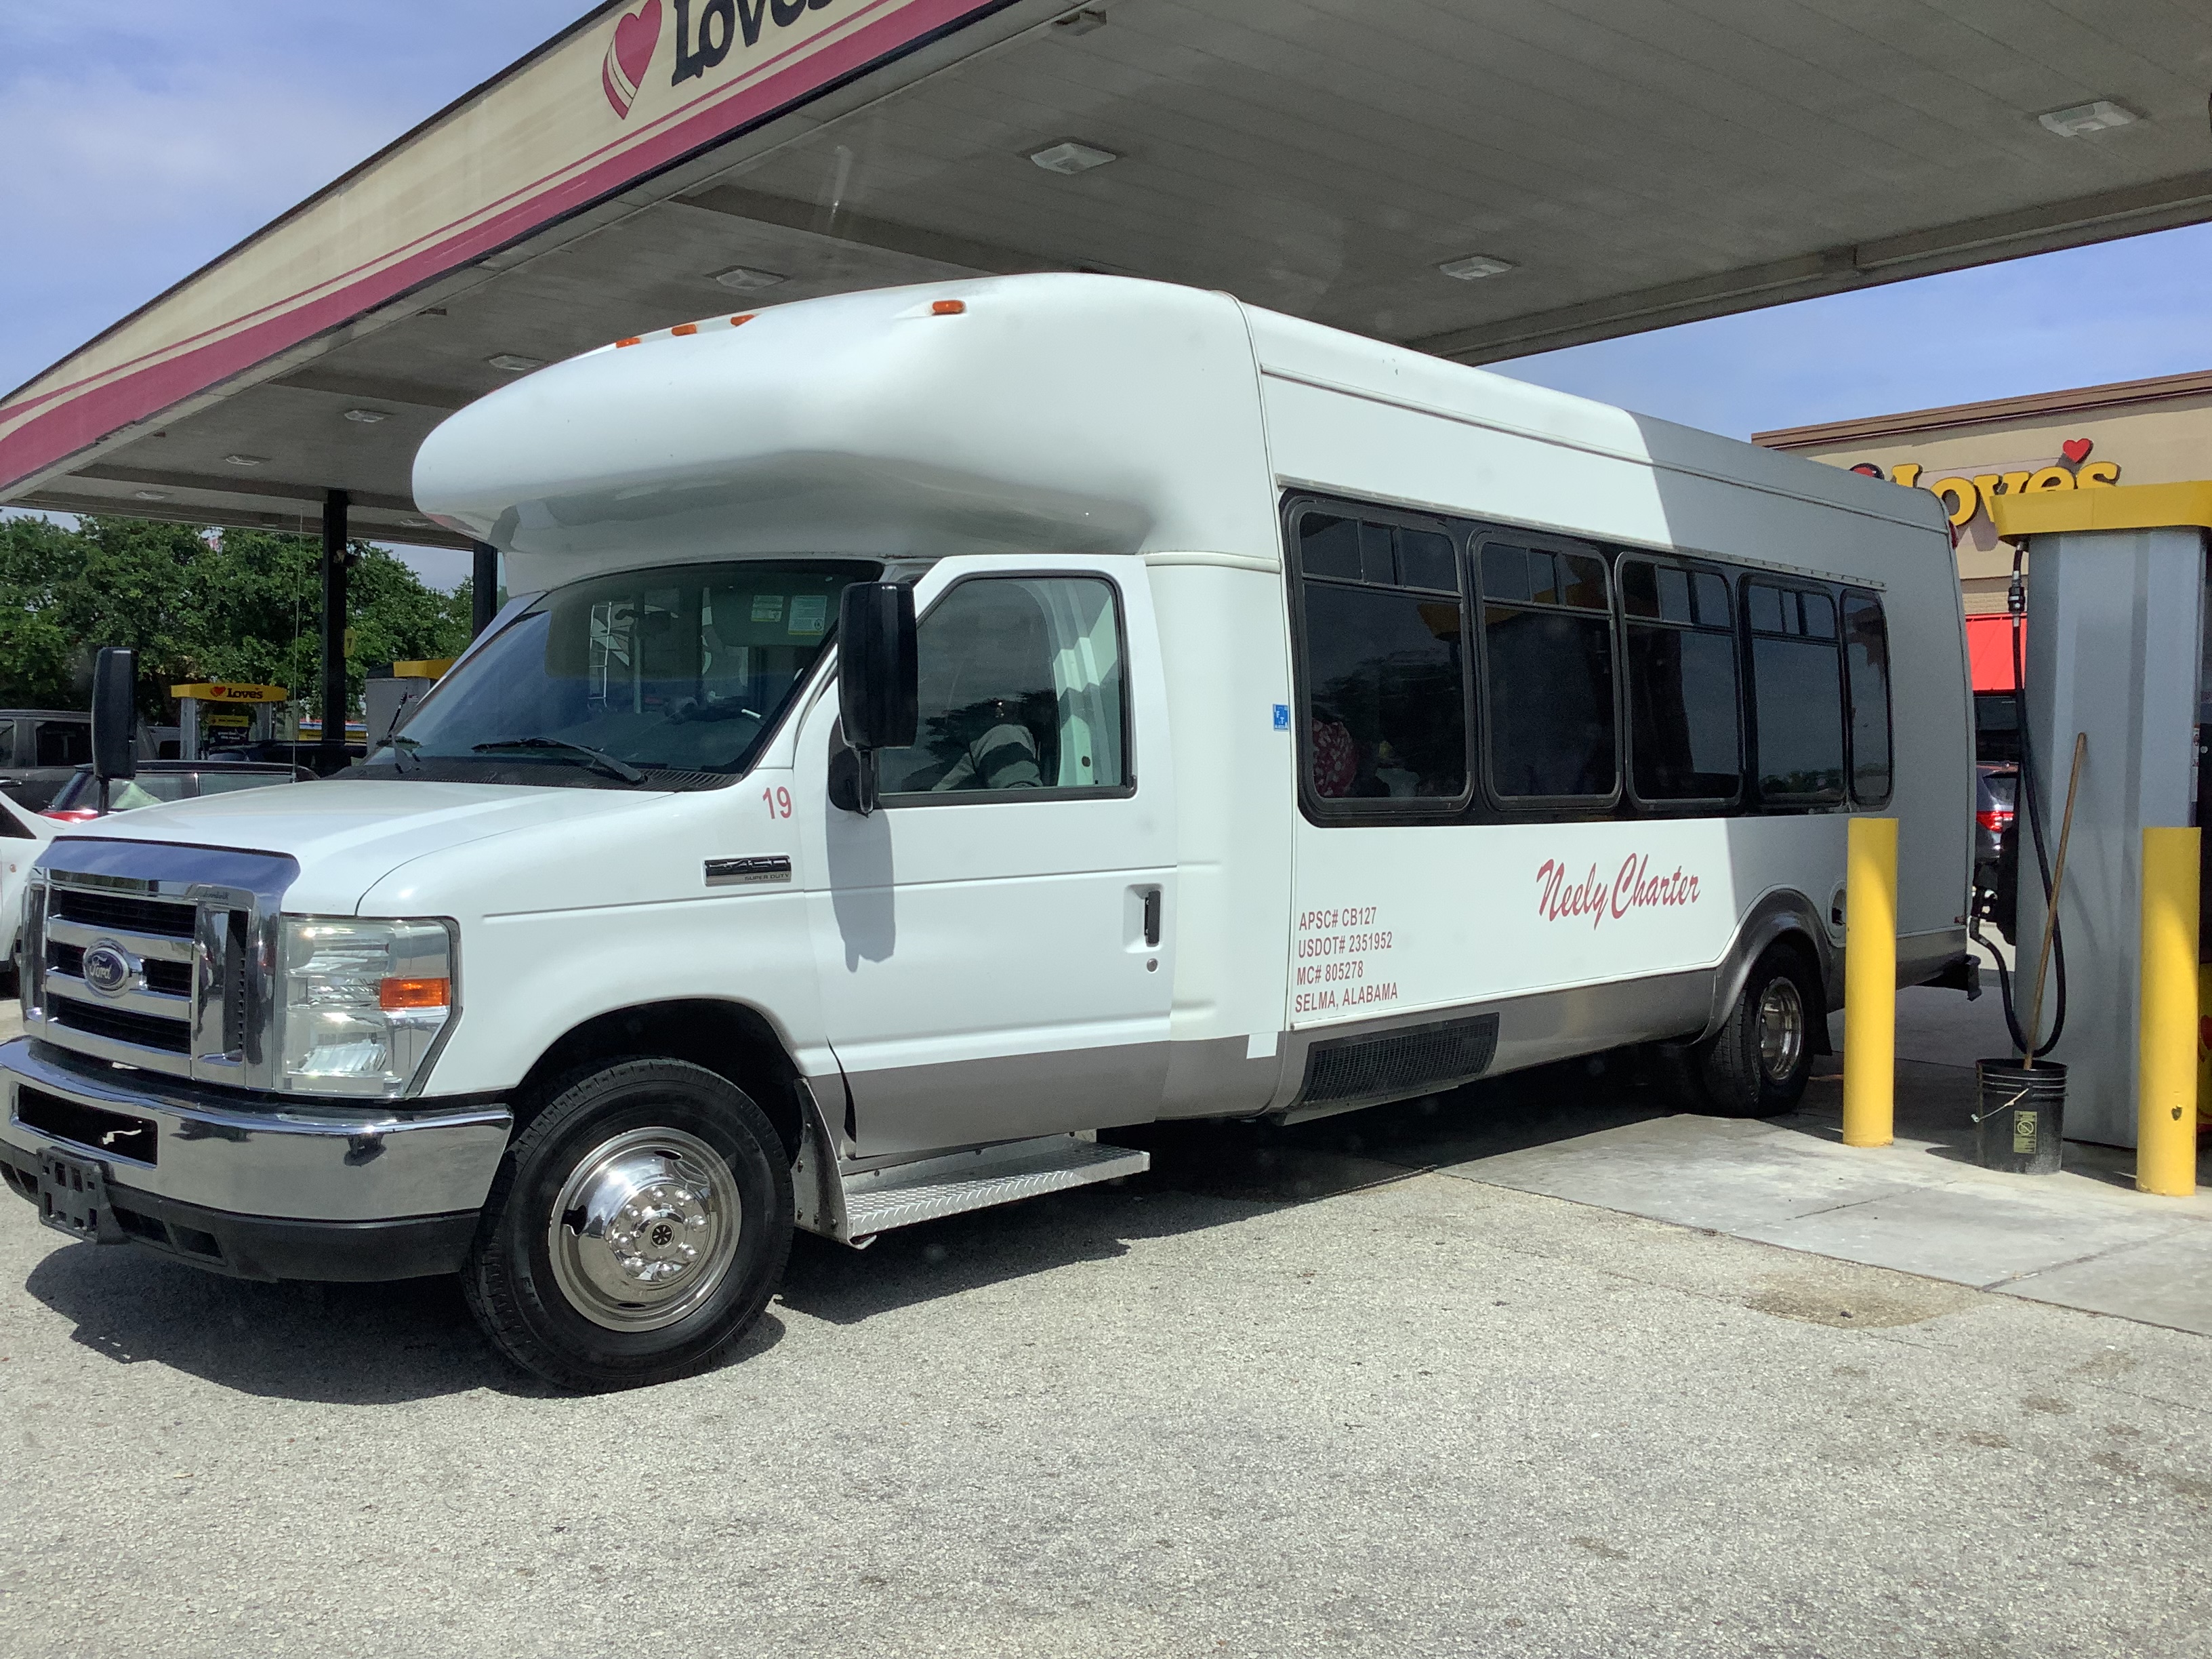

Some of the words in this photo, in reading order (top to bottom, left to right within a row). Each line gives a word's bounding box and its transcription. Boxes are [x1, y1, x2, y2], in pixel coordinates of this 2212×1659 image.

[672, 0, 834, 87] Lov
[762, 786, 792, 819] 19
[1536, 859, 1608, 930] Neely
[1612, 853, 1700, 919] Charter
[1298, 909, 1338, 931] APSC#
[1342, 907, 1377, 926] CB127
[1298, 935, 1345, 958] USDOT#
[1349, 931, 1393, 953] 2351952
[89, 955, 113, 980] Ford
[1296, 964, 1322, 985] MC#
[1325, 960, 1364, 982] 805278
[1295, 990, 1339, 1013] SELMA,
[1342, 982, 1398, 1006] ALABAMA
